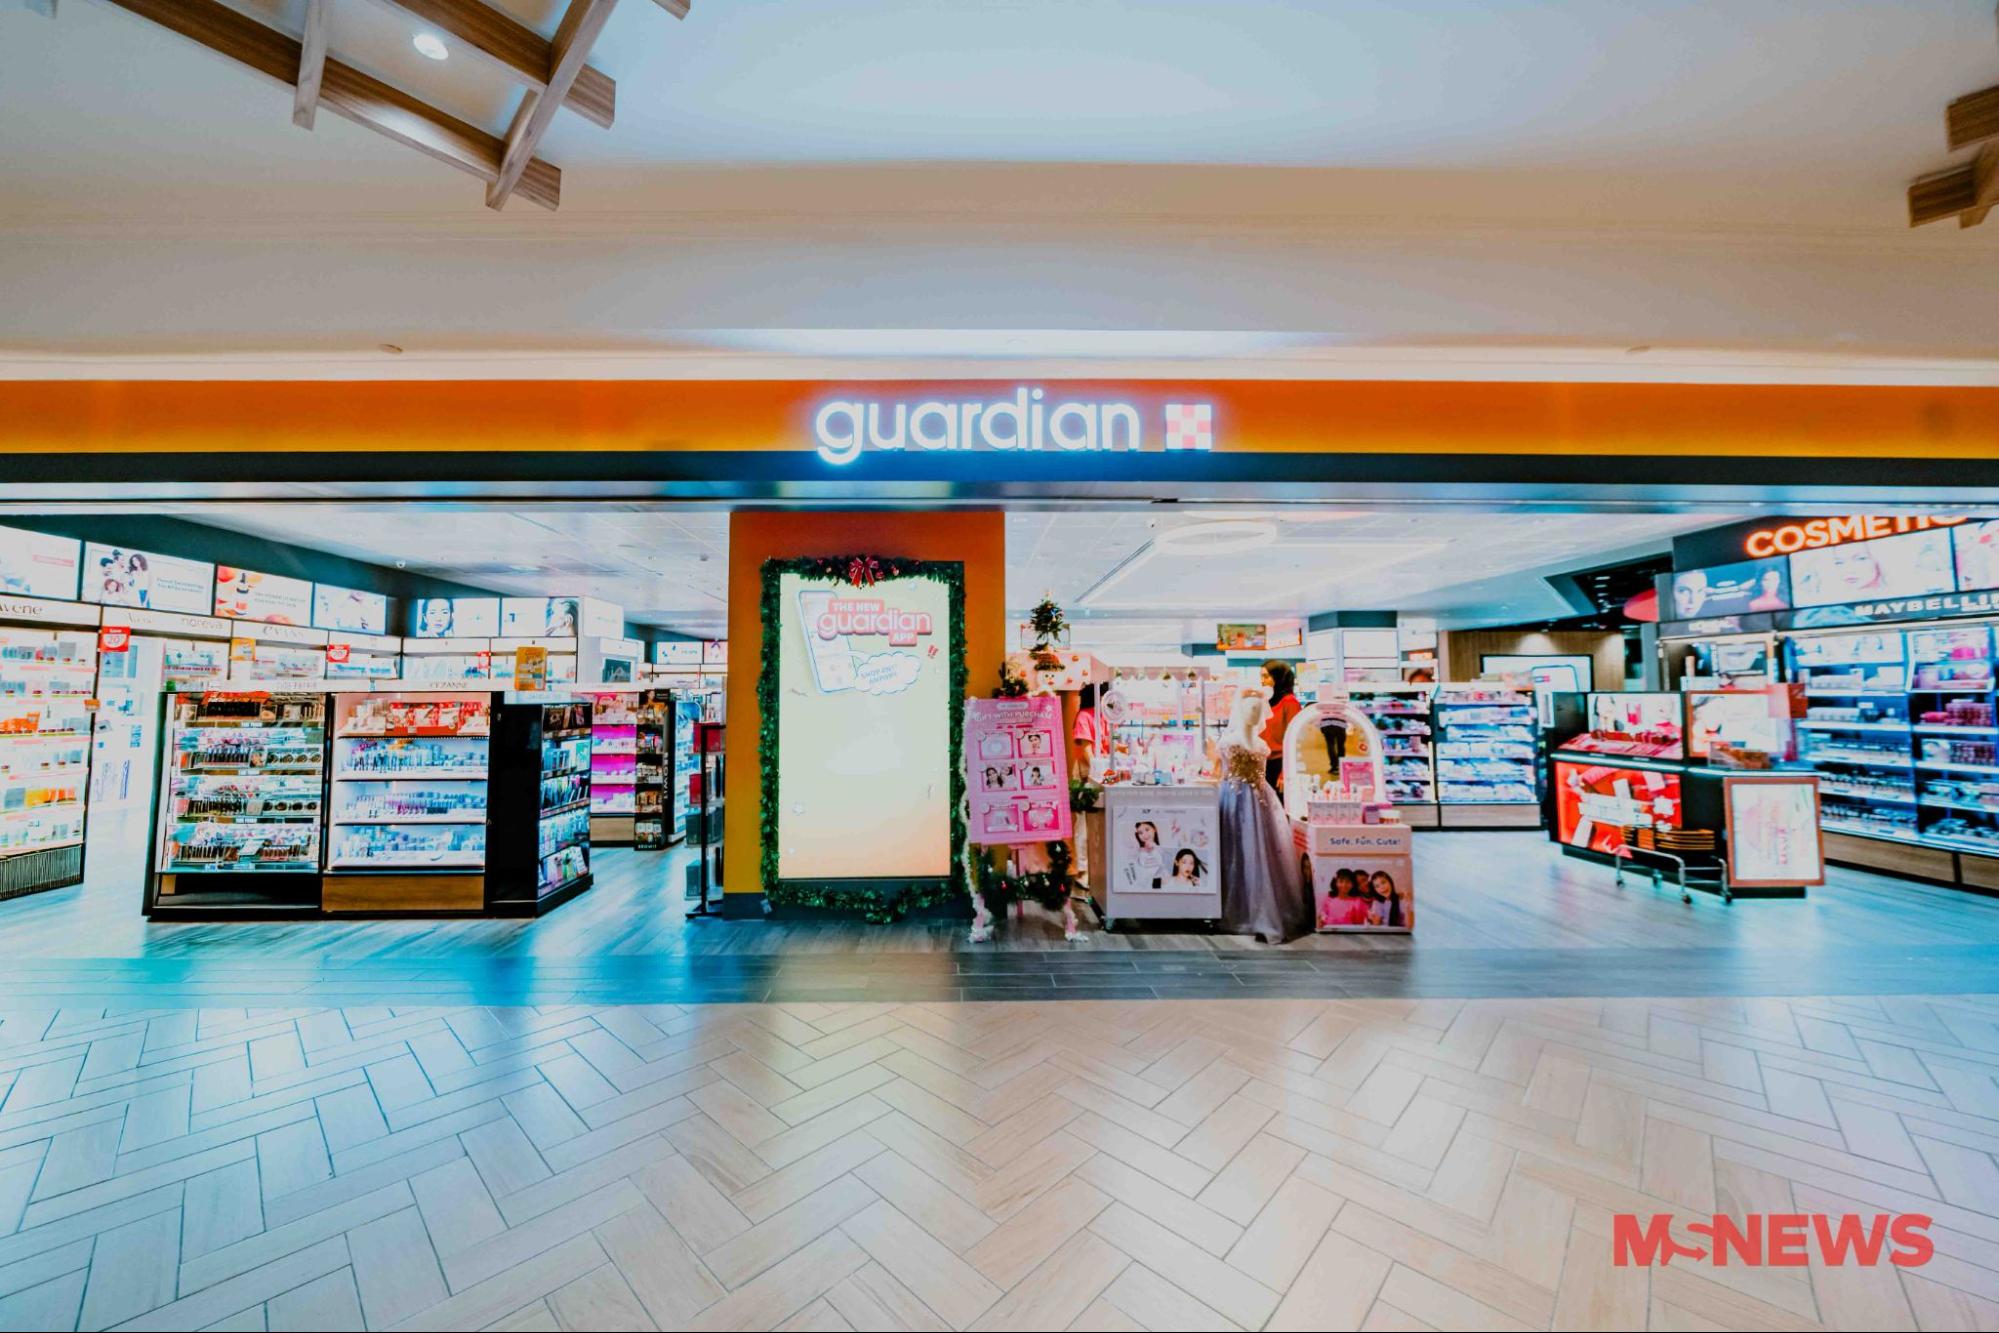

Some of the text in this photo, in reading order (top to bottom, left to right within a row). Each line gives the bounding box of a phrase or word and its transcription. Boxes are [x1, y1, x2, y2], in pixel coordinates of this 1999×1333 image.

[816, 387, 1140, 465] guardian
[832, 603, 880, 612] THE NEW
[818, 609, 931, 638] guardian
[893, 633, 914, 641] APP
[1330, 837, 1353, 846] Safe.
